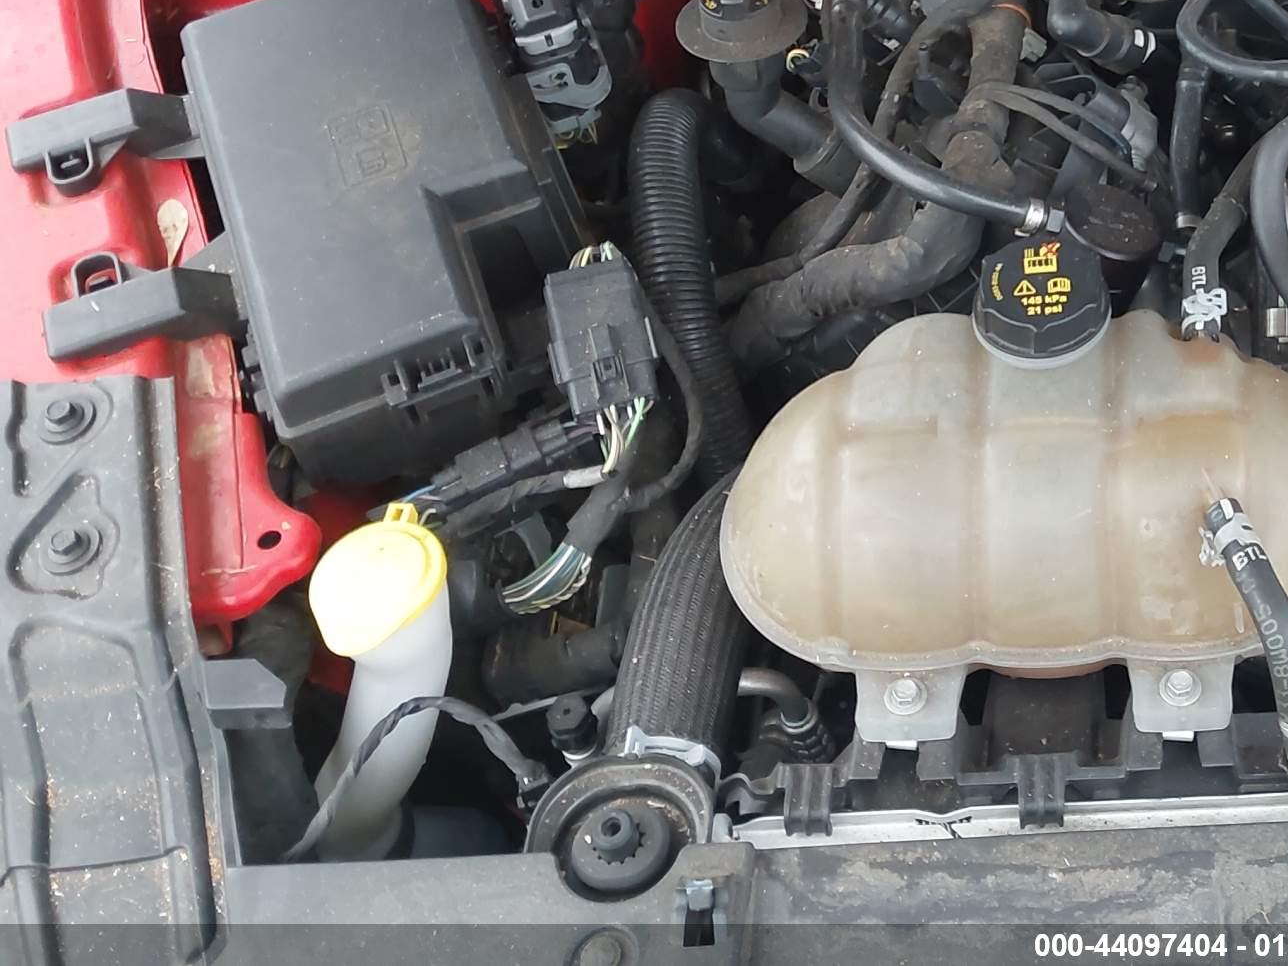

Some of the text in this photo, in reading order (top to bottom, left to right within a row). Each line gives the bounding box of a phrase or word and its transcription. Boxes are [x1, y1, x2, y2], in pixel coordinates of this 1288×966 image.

[1044, 294, 1068, 304] kPa
[1026, 304, 1063, 316] 21 psi
